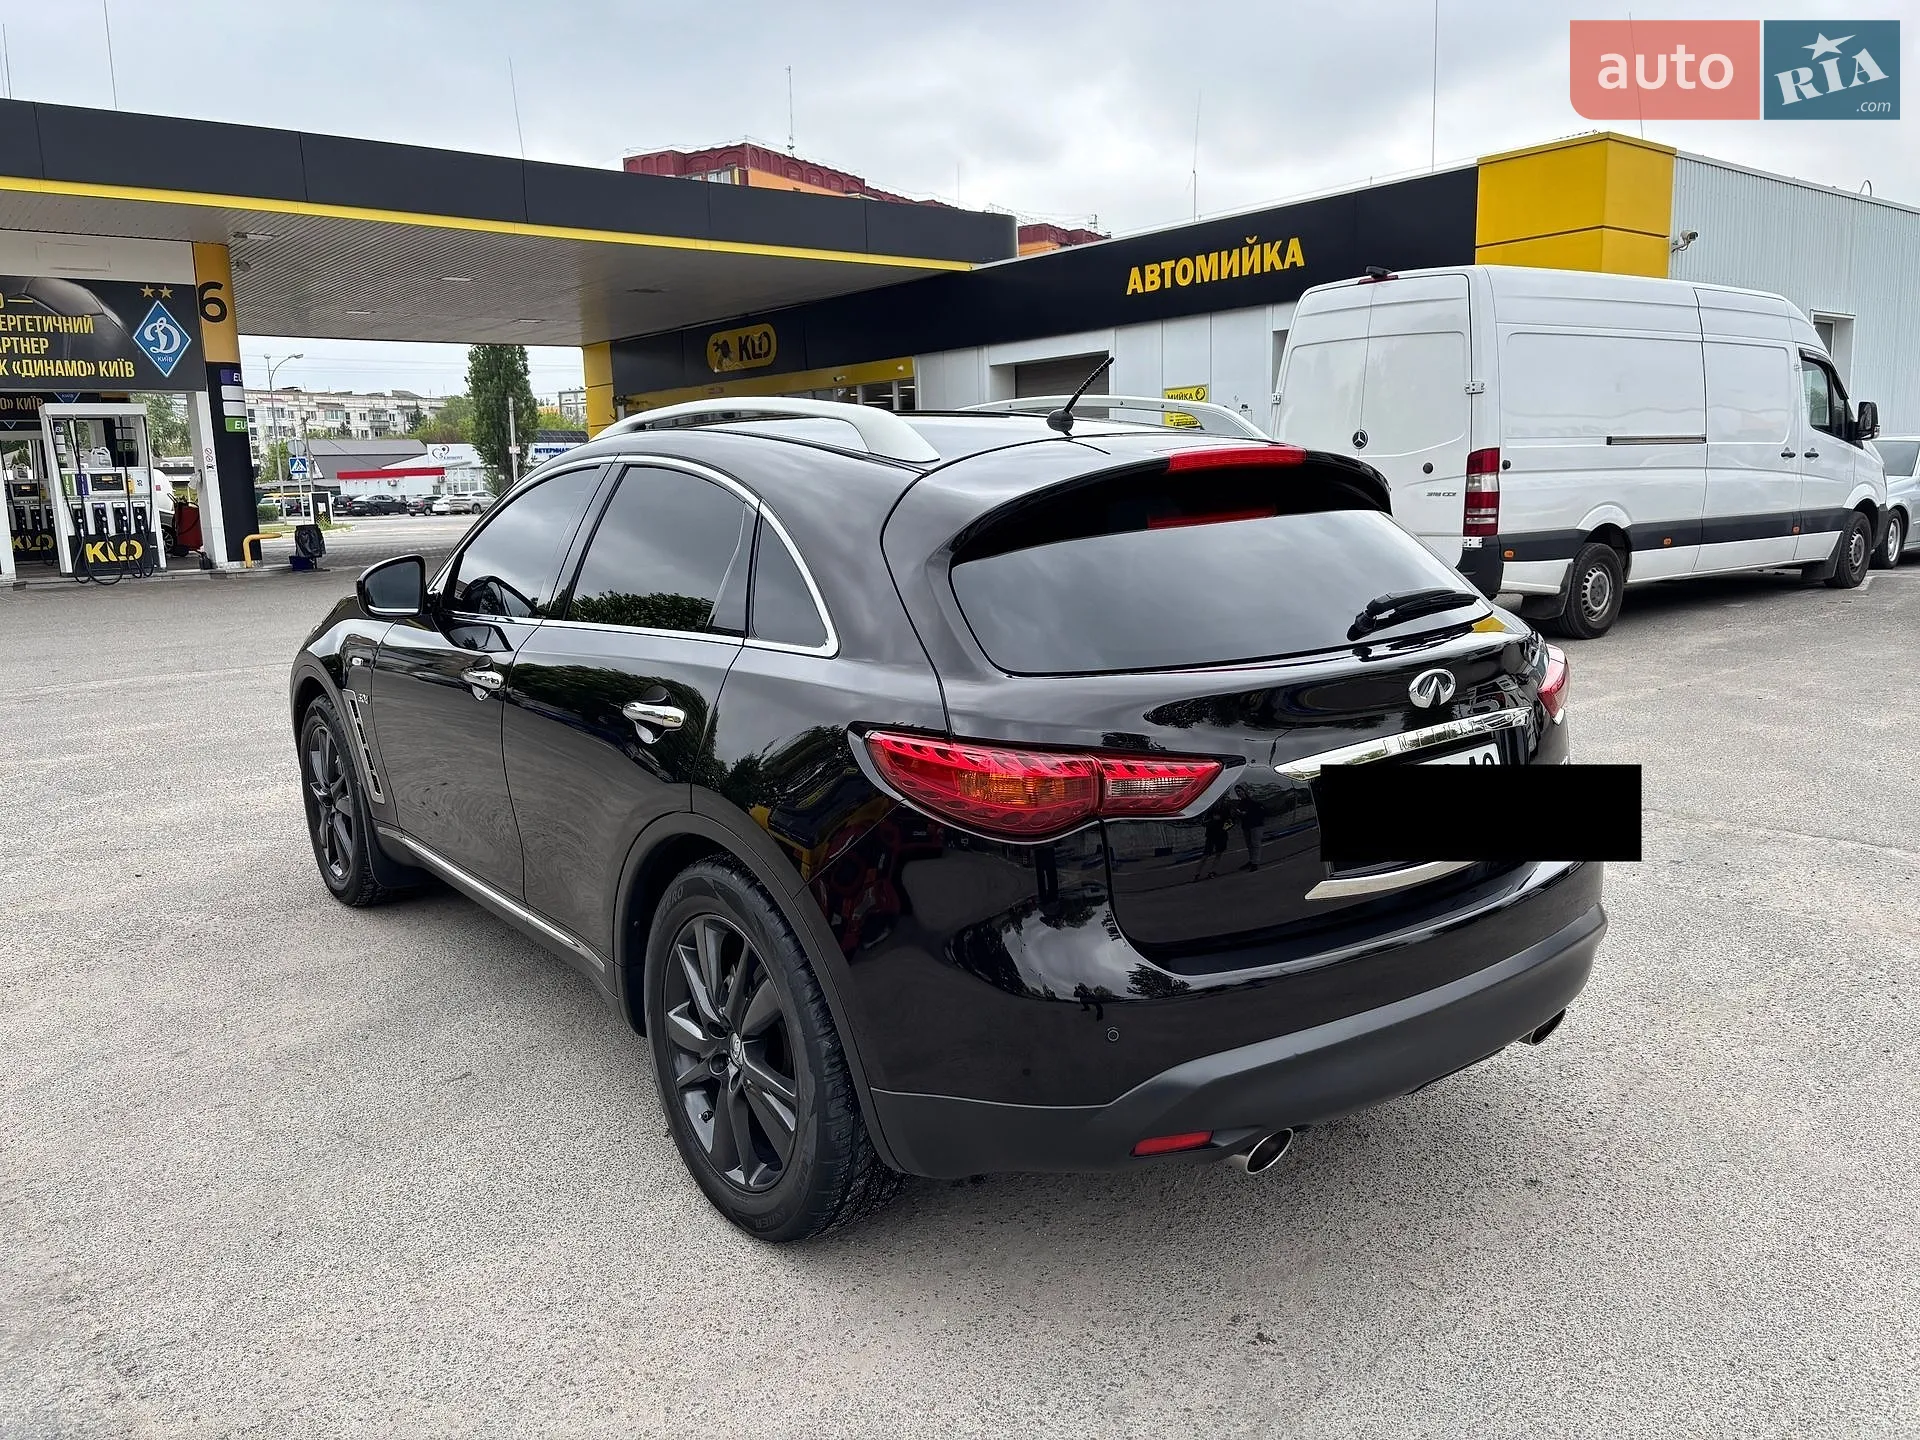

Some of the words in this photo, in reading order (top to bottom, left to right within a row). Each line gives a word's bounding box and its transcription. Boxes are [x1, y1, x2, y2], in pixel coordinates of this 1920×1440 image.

[1126, 235, 1305, 296] АВТОМИЙКА
[199, 281, 227, 322] 6
[0, 337, 49, 355] РТНЕР
[738, 331, 772, 361] KLO
[12, 360, 95, 378] «ДИНАМО»
[99, 359, 135, 378] КИЇВ
[157, 355, 173, 363] КИЇВ
[85, 539, 143, 564] KLO
